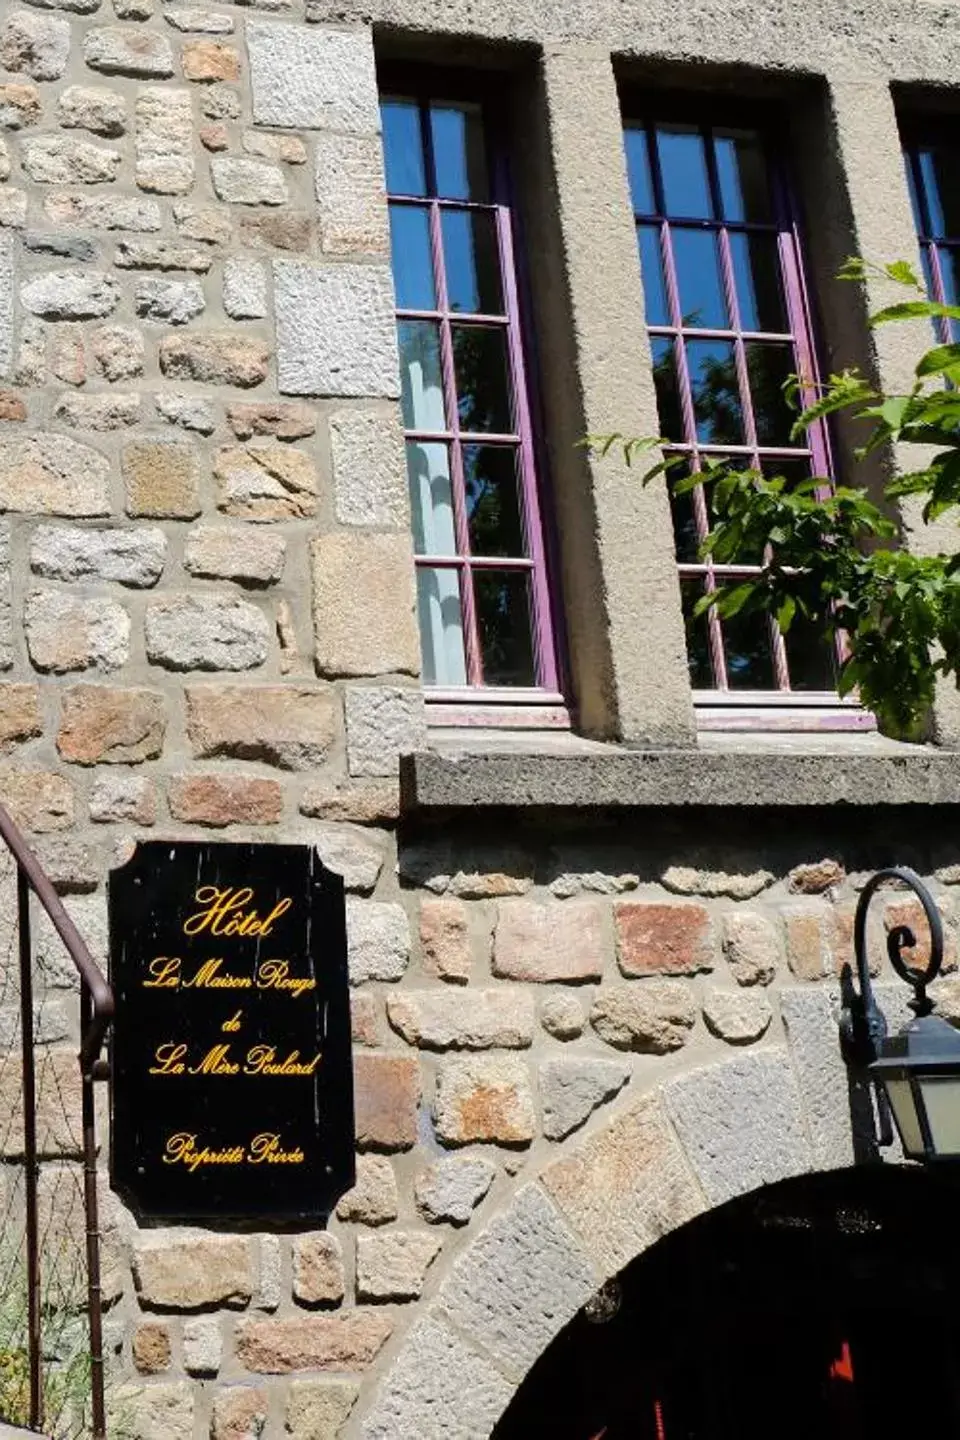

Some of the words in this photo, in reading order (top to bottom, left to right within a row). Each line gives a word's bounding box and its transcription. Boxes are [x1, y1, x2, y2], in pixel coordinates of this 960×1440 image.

[183, 886, 292, 937] Hôtel
[142, 957, 180, 987] La
[182, 957, 252, 988] Maison
[257, 959, 317, 998] Rouge
[221, 1009, 243, 1032] de
[149, 1044, 185, 1074] La
[189, 1044, 240, 1075] Mère
[243, 1045, 322, 1075] Poulard
[162, 1132, 245, 1172] Propriété
[247, 1132, 305, 1164] Privée
